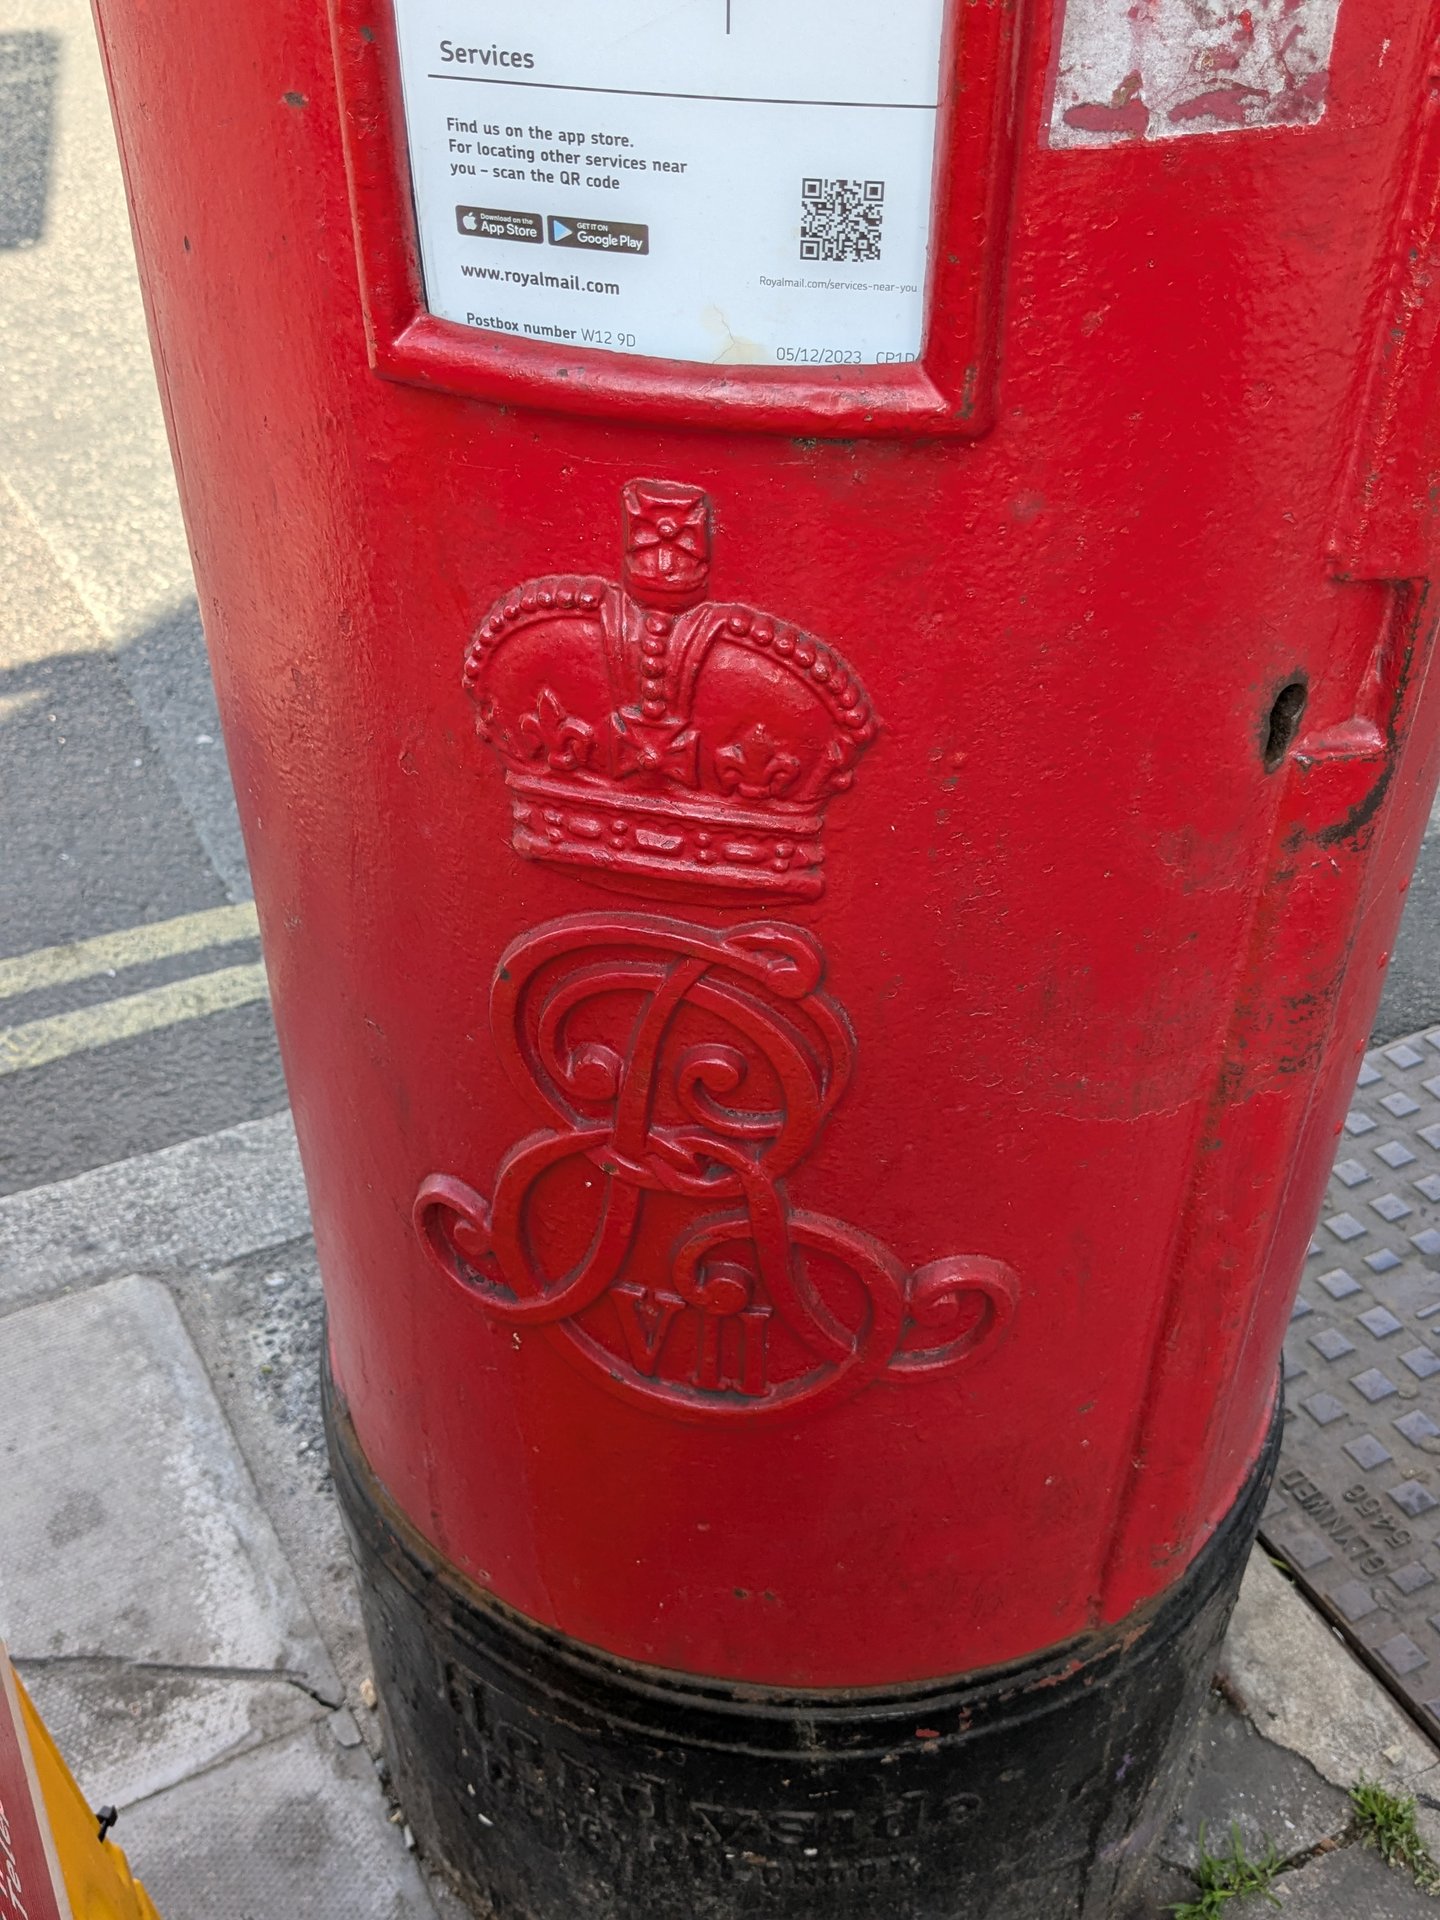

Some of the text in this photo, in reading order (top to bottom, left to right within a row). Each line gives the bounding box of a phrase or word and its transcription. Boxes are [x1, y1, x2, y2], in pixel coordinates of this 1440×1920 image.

[439, 40, 535, 69] Services
[447, 117, 634, 148] Find us on the app store.
[449, 139, 688, 173] For locating other services near
[450, 162, 476, 176] you
[493, 166, 525, 181] scan
[530, 169, 554, 183] the
[559, 171, 581, 186] QR
[586, 175, 620, 190] code
[480, 213, 512, 223] Download
[481, 220, 538, 238] App Store
[577, 222, 590, 230] GET
[597, 224, 608, 232] ON
[577, 231, 643, 251] Google Play
[461, 264, 620, 295] www.royalmail.com
[759, 276, 918, 294] Royalmail.com/services-near-you
[467, 312, 636, 347] Postbox number W12 9D
[776, 347, 862, 364] 05/12/2023
[1279, 1468, 1386, 1577] GLYNWED
